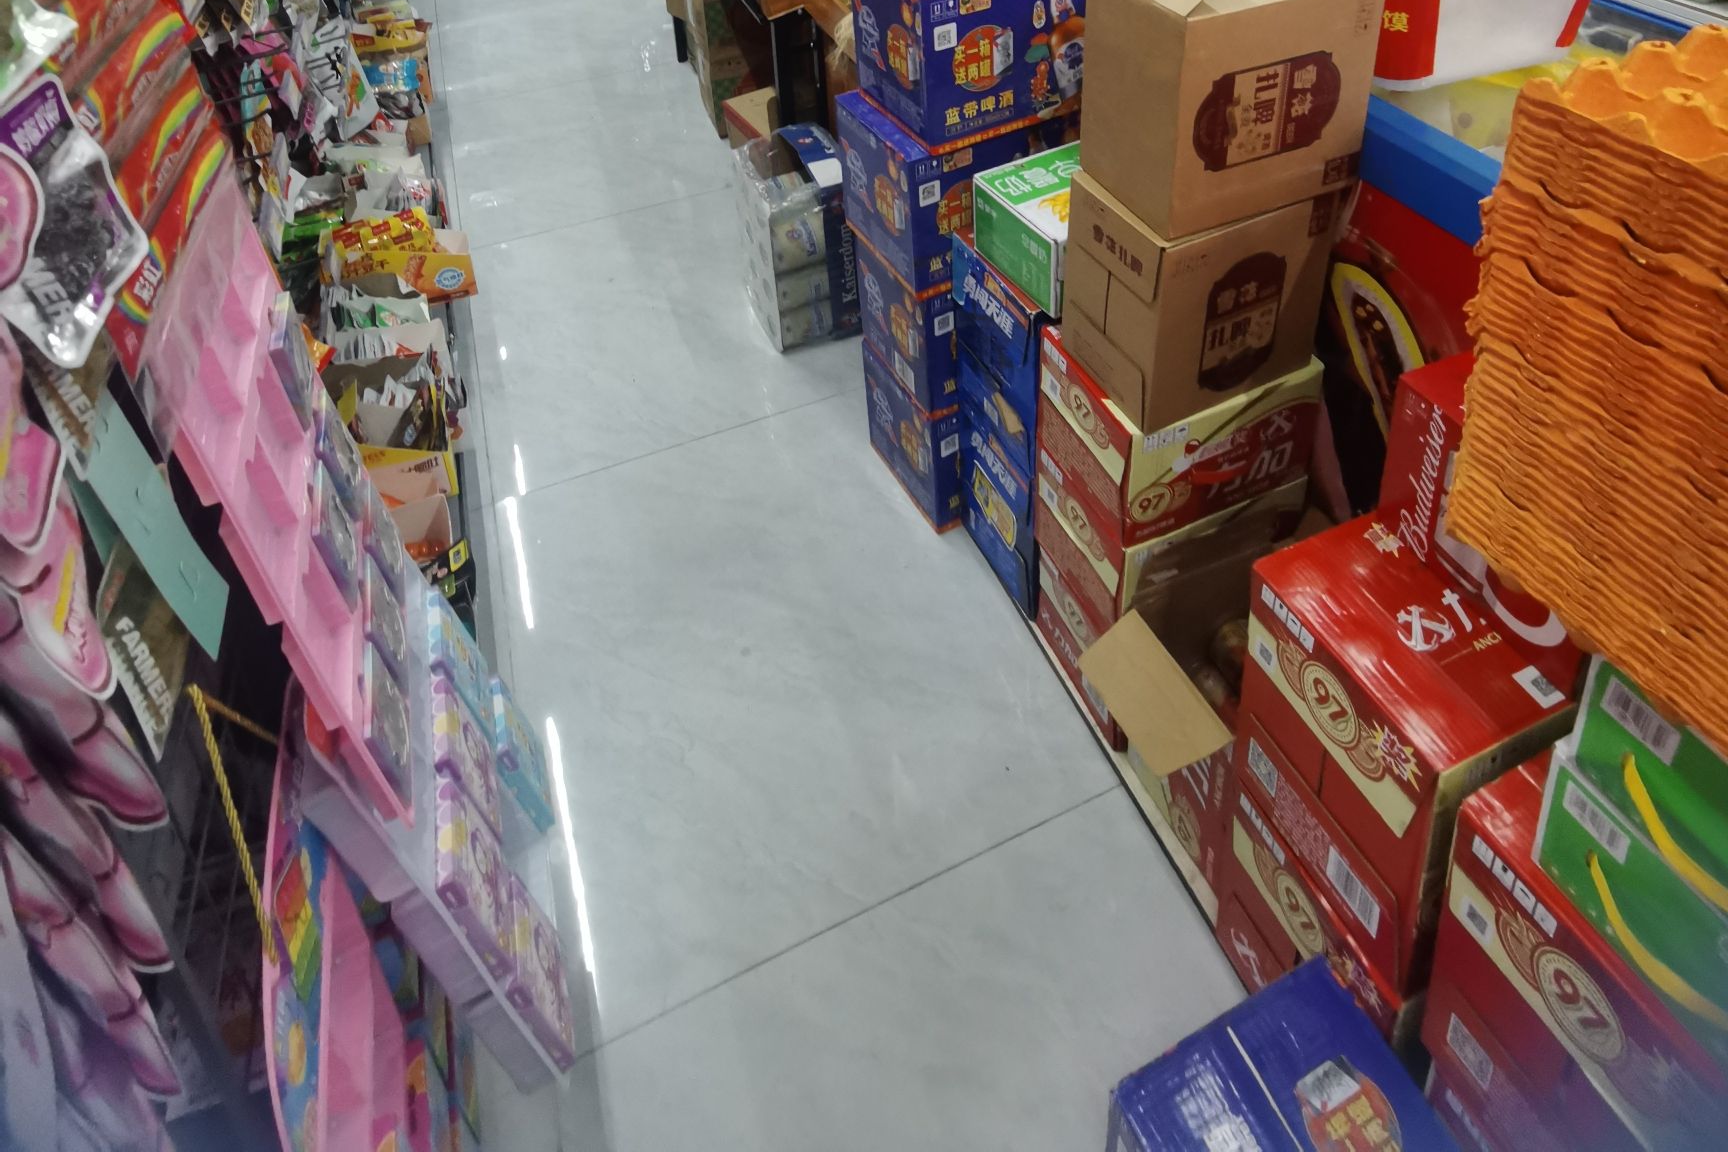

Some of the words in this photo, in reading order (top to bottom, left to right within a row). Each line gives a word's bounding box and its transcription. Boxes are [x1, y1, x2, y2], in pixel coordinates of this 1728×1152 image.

[945, 89, 1014, 126] 蓝带啤酒
[1139, 493, 1165, 514] 97
[1397, 403, 1447, 563] Budweiser
[1312, 676, 1349, 722] 97
[1552, 966, 1612, 1031] 97
